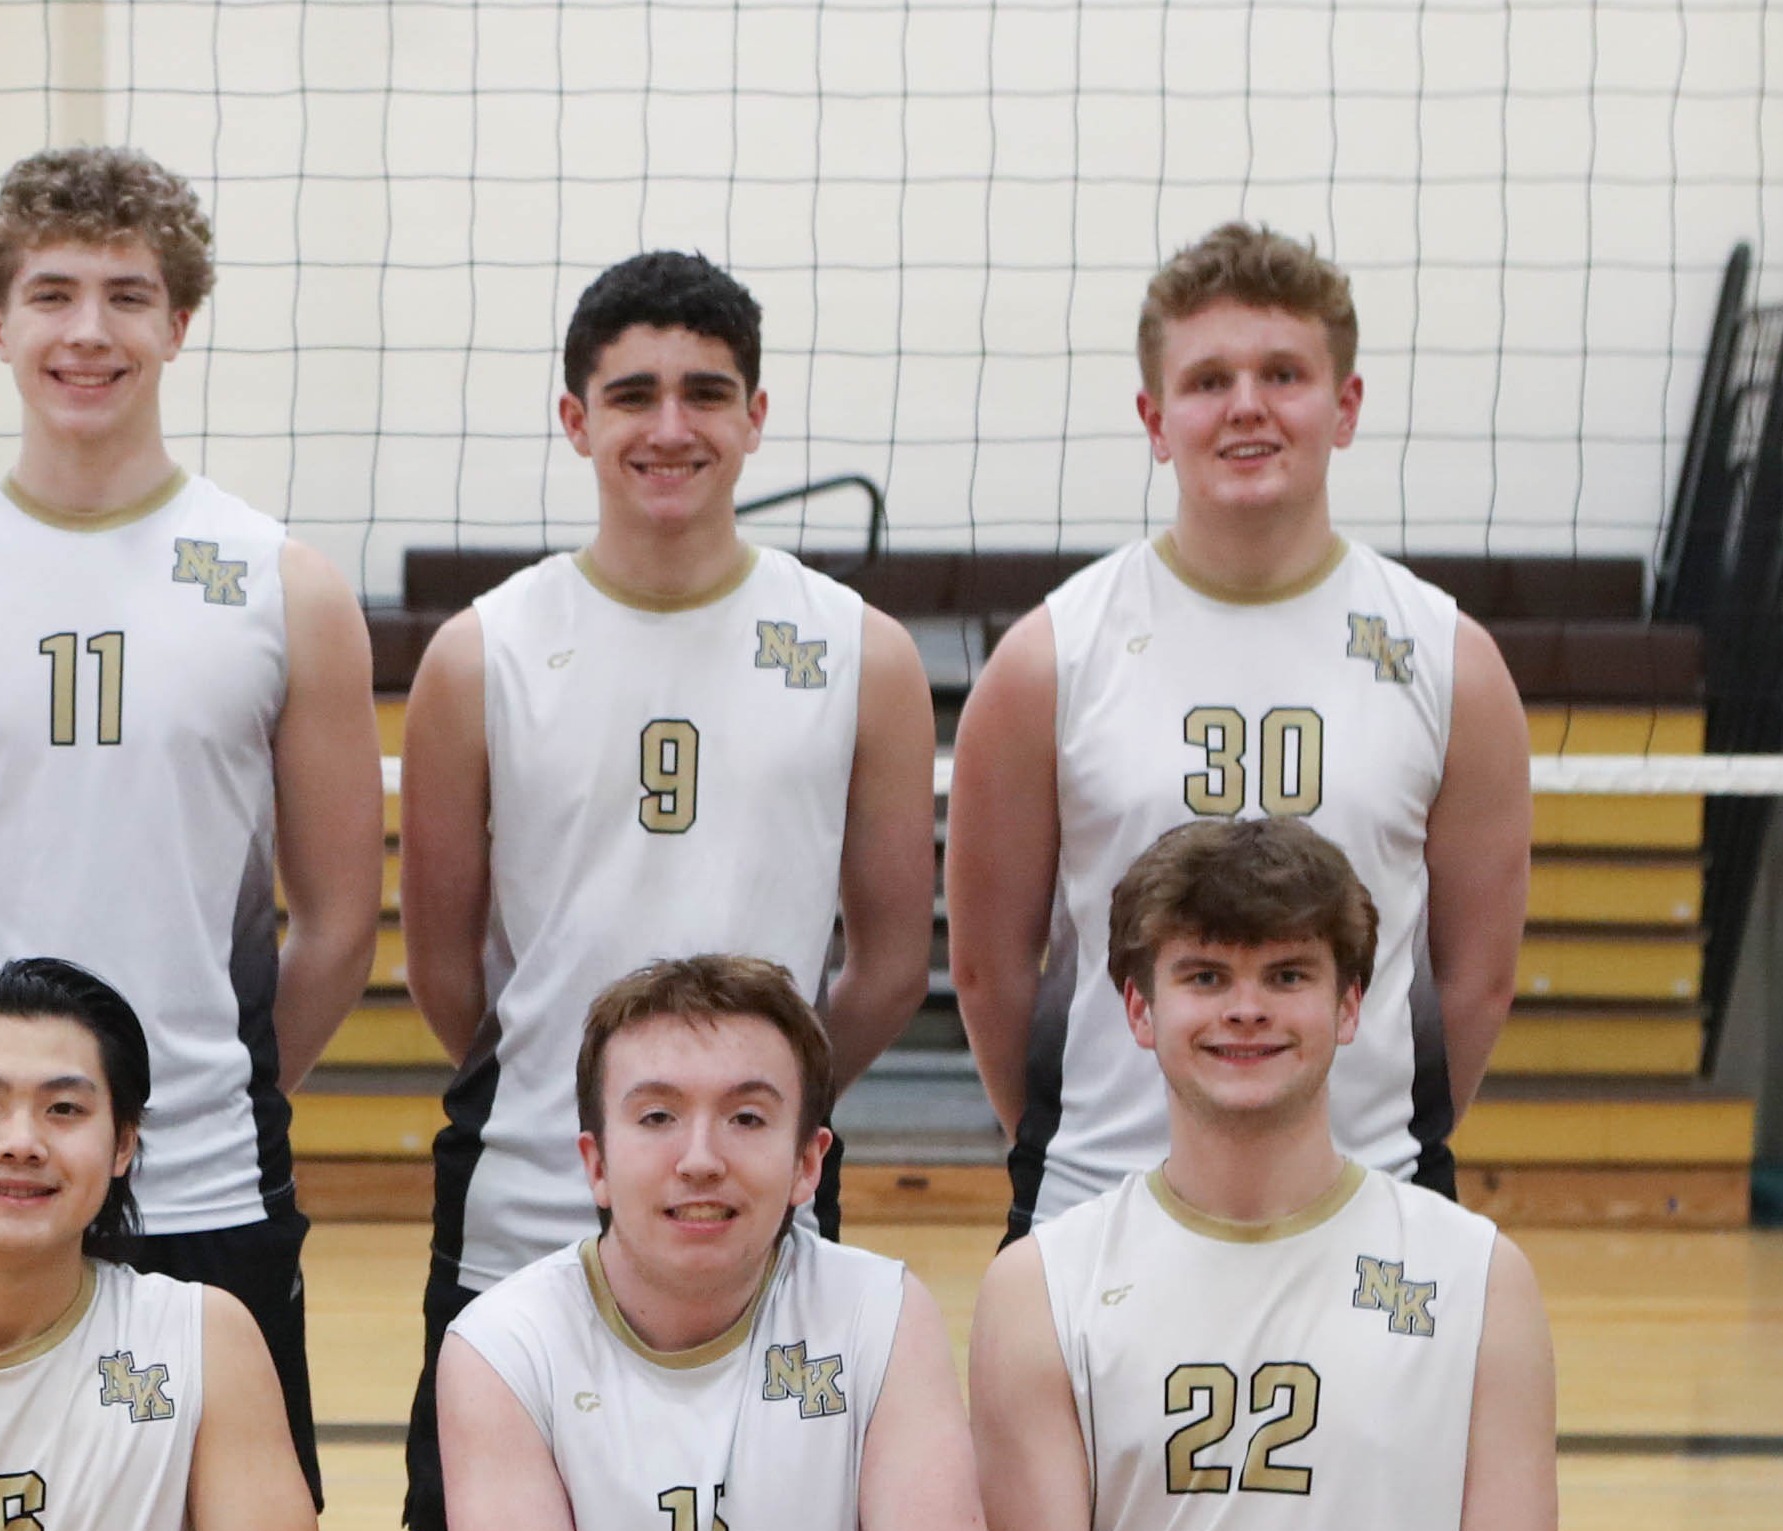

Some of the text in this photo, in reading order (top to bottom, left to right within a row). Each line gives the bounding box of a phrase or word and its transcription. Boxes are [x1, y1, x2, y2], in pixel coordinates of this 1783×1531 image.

[173, 537, 246, 606] NK
[39, 631, 124, 745] 11
[755, 620, 826, 688] NK
[1347, 612, 1414, 684] NK
[639, 719, 699, 834] 9
[1184, 706, 1323, 817] 30
[1353, 1255, 1436, 1337] NK
[99, 1350, 174, 1423] NK
[763, 1340, 847, 1419] NK
[1165, 1362, 1321, 1495] 22
